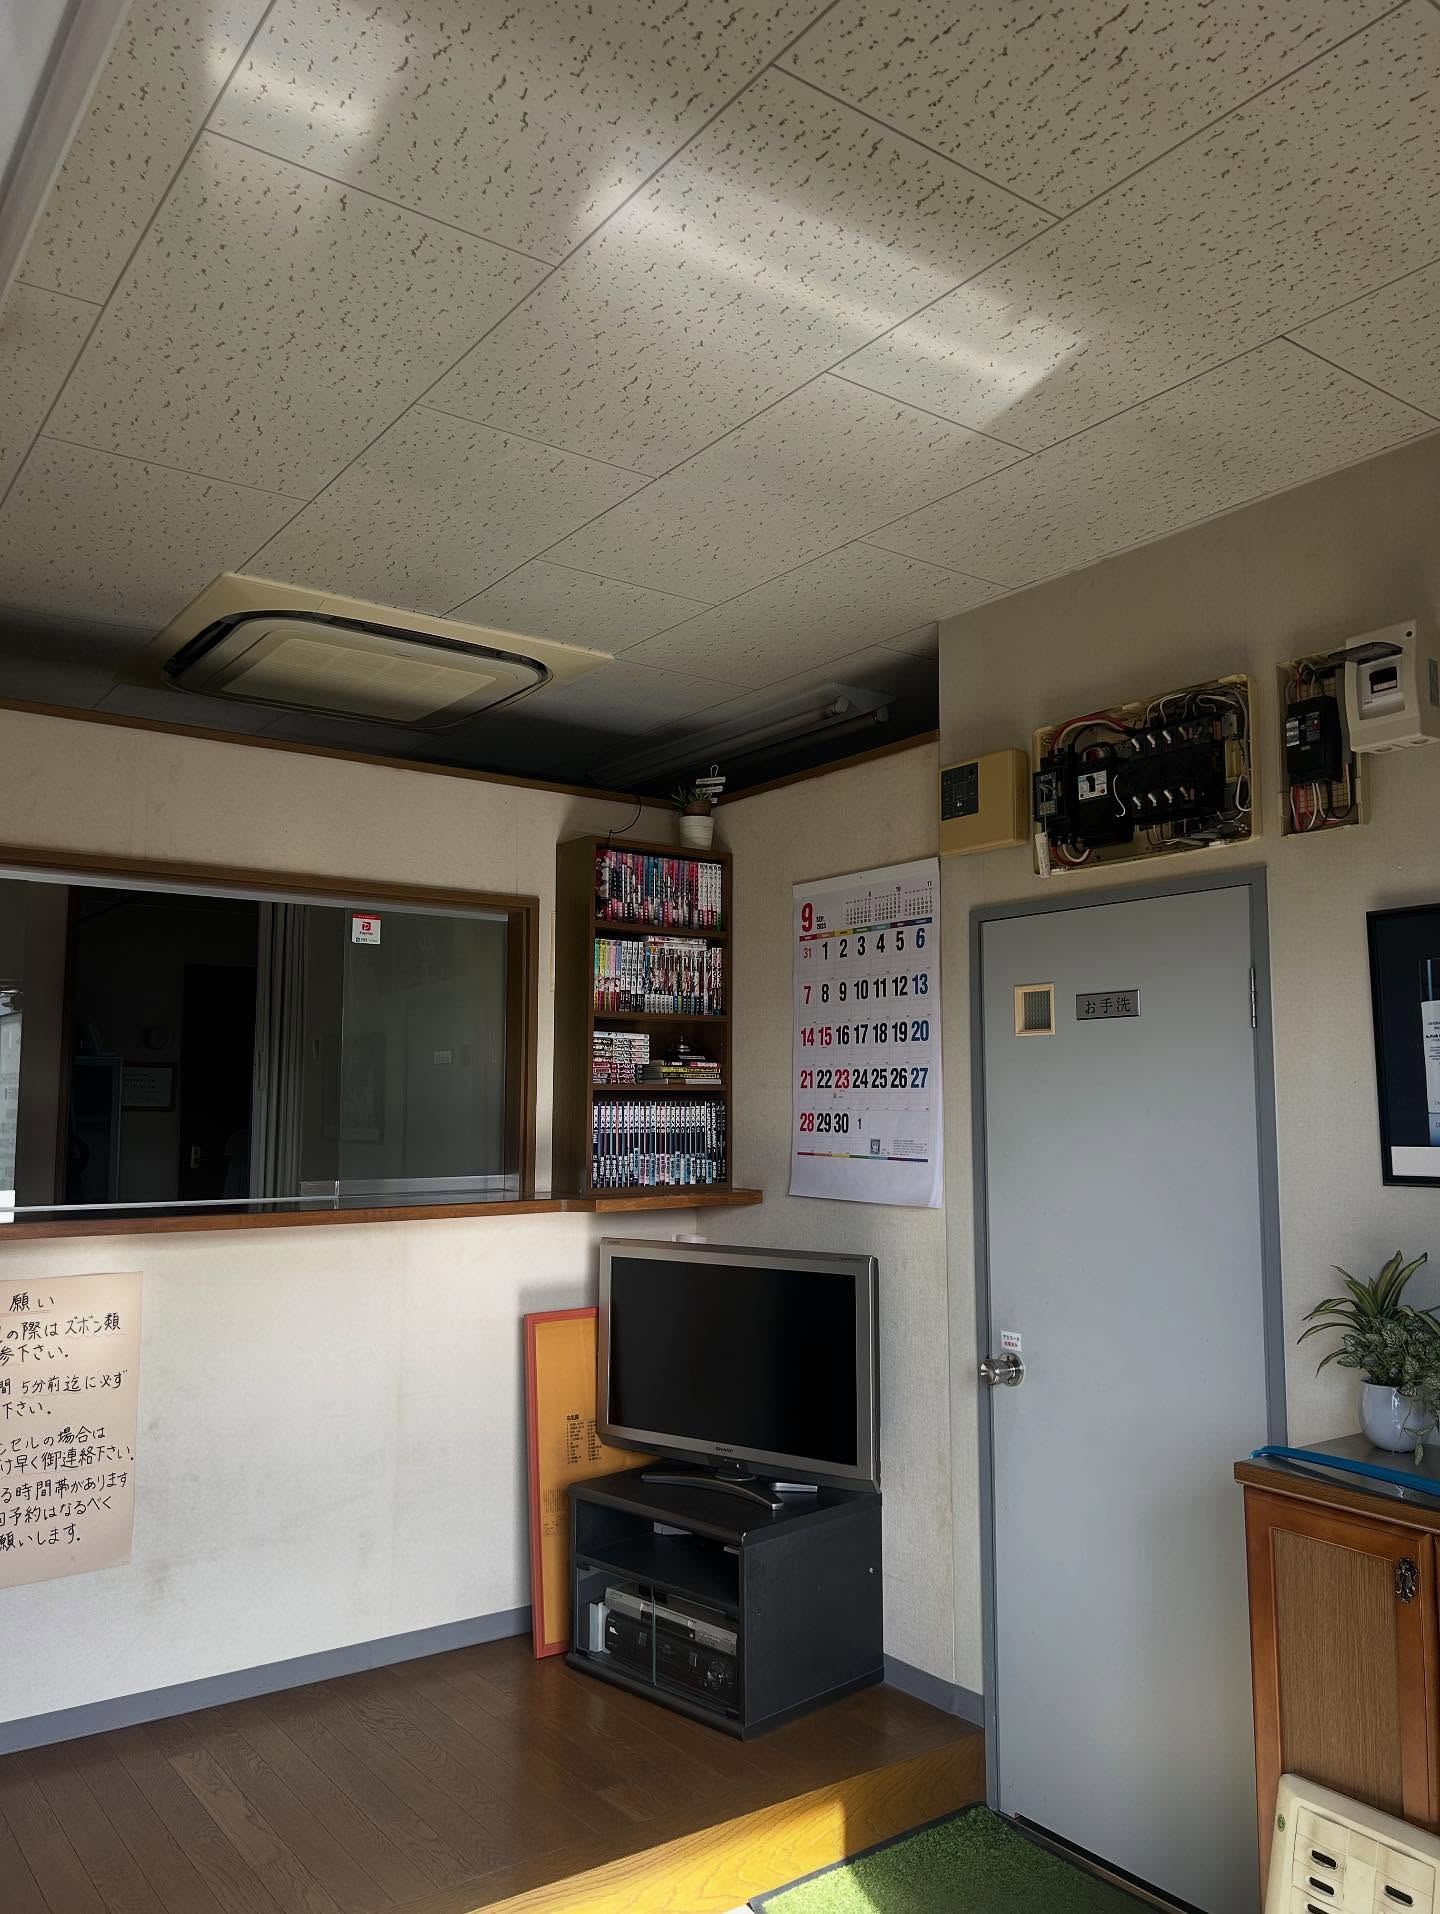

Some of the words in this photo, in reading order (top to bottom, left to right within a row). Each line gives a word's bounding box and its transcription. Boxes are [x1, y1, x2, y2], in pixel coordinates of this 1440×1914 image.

[802, 902, 813, 932] 9
[804, 948, 812, 959] 31
[822, 942, 828, 960] 1
[840, 938, 848, 958] 2
[857, 936, 866, 956] 3
[876, 933, 885, 953] 4
[896, 931, 904, 951] 5
[916, 928, 925, 949] 6
[804, 986, 811, 1004] 7
[822, 984, 829, 1003] 8
[840, 982, 847, 1001] 9
[854, 980, 868, 1000] 10
[874, 978, 886, 998] 11
[892, 976, 908, 996] 12
[912, 973, 928, 995] 13
[1084, 996, 1130, 1014] お手洗
[801, 1027, 814, 1046] 14
[818, 1026, 832, 1046] 15
[836, 1025, 850, 1045] 16
[854, 1024, 868, 1044] 17
[873, 1023, 887, 1043] 18
[892, 1022, 907, 1042] 19
[912, 1020, 929, 1042] 20
[800, 1070, 813, 1088] 21
[817, 1070, 832, 1088] 22
[834, 1069, 850, 1089] 23
[853, 1069, 868, 1088] 24
[871, 1068, 887, 1088] 25
[891, 1068, 907, 1088] 26
[911, 1068, 928, 1088] 27
[800, 1113, 814, 1132] 28
[816, 1113, 832, 1132] 29
[834, 1113, 849, 1133] 30
[858, 1118, 861, 1129] 1
[9, 1292, 54, 1312] 願い
